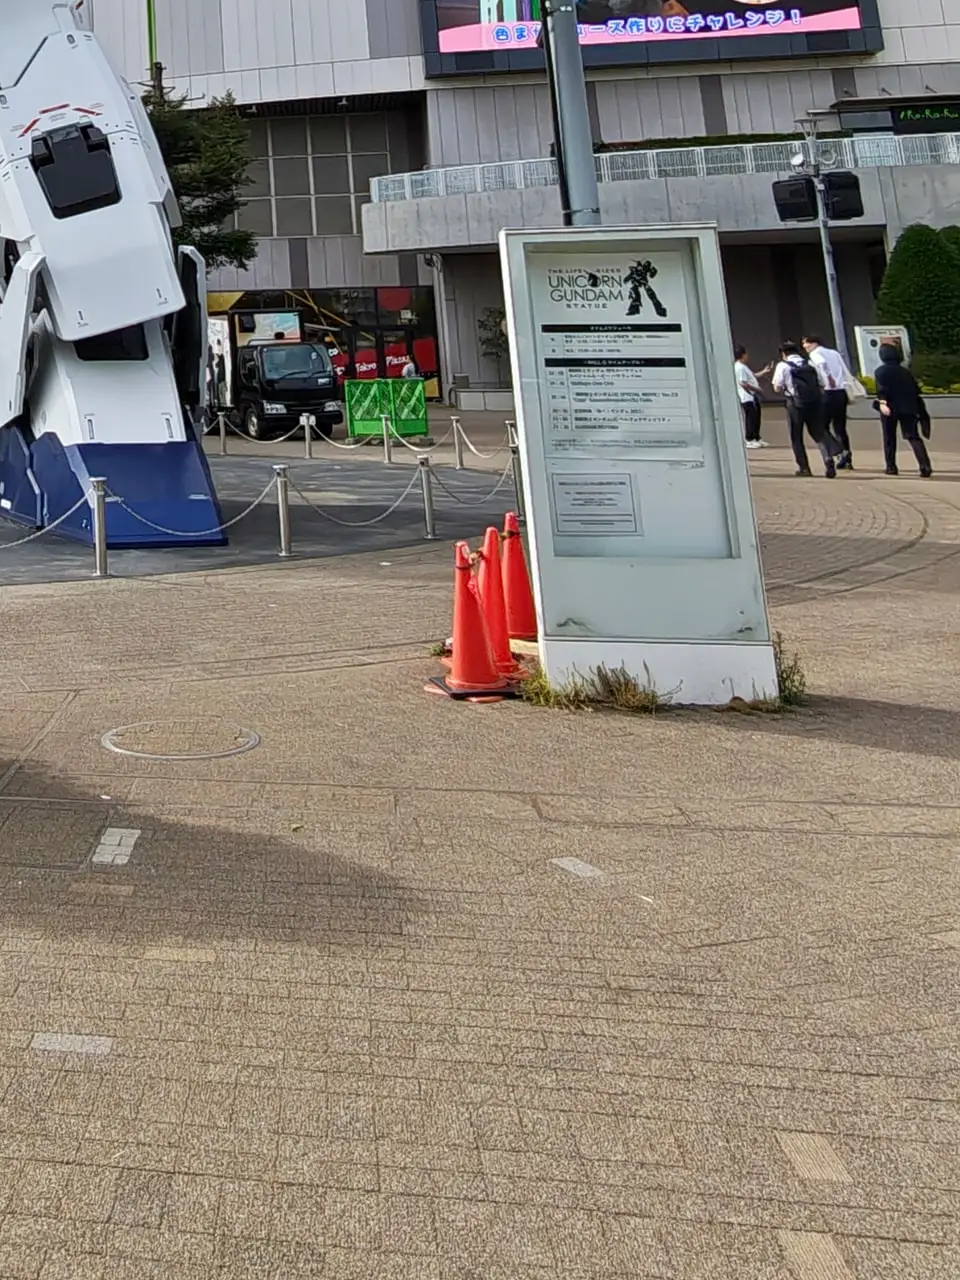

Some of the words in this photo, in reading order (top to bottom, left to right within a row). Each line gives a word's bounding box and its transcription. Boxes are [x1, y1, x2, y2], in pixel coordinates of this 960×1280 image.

[548, 273, 623, 288] UNICORN
[550, 288, 623, 302] GUNDAM
[355, 362, 377, 373] Tokyo
